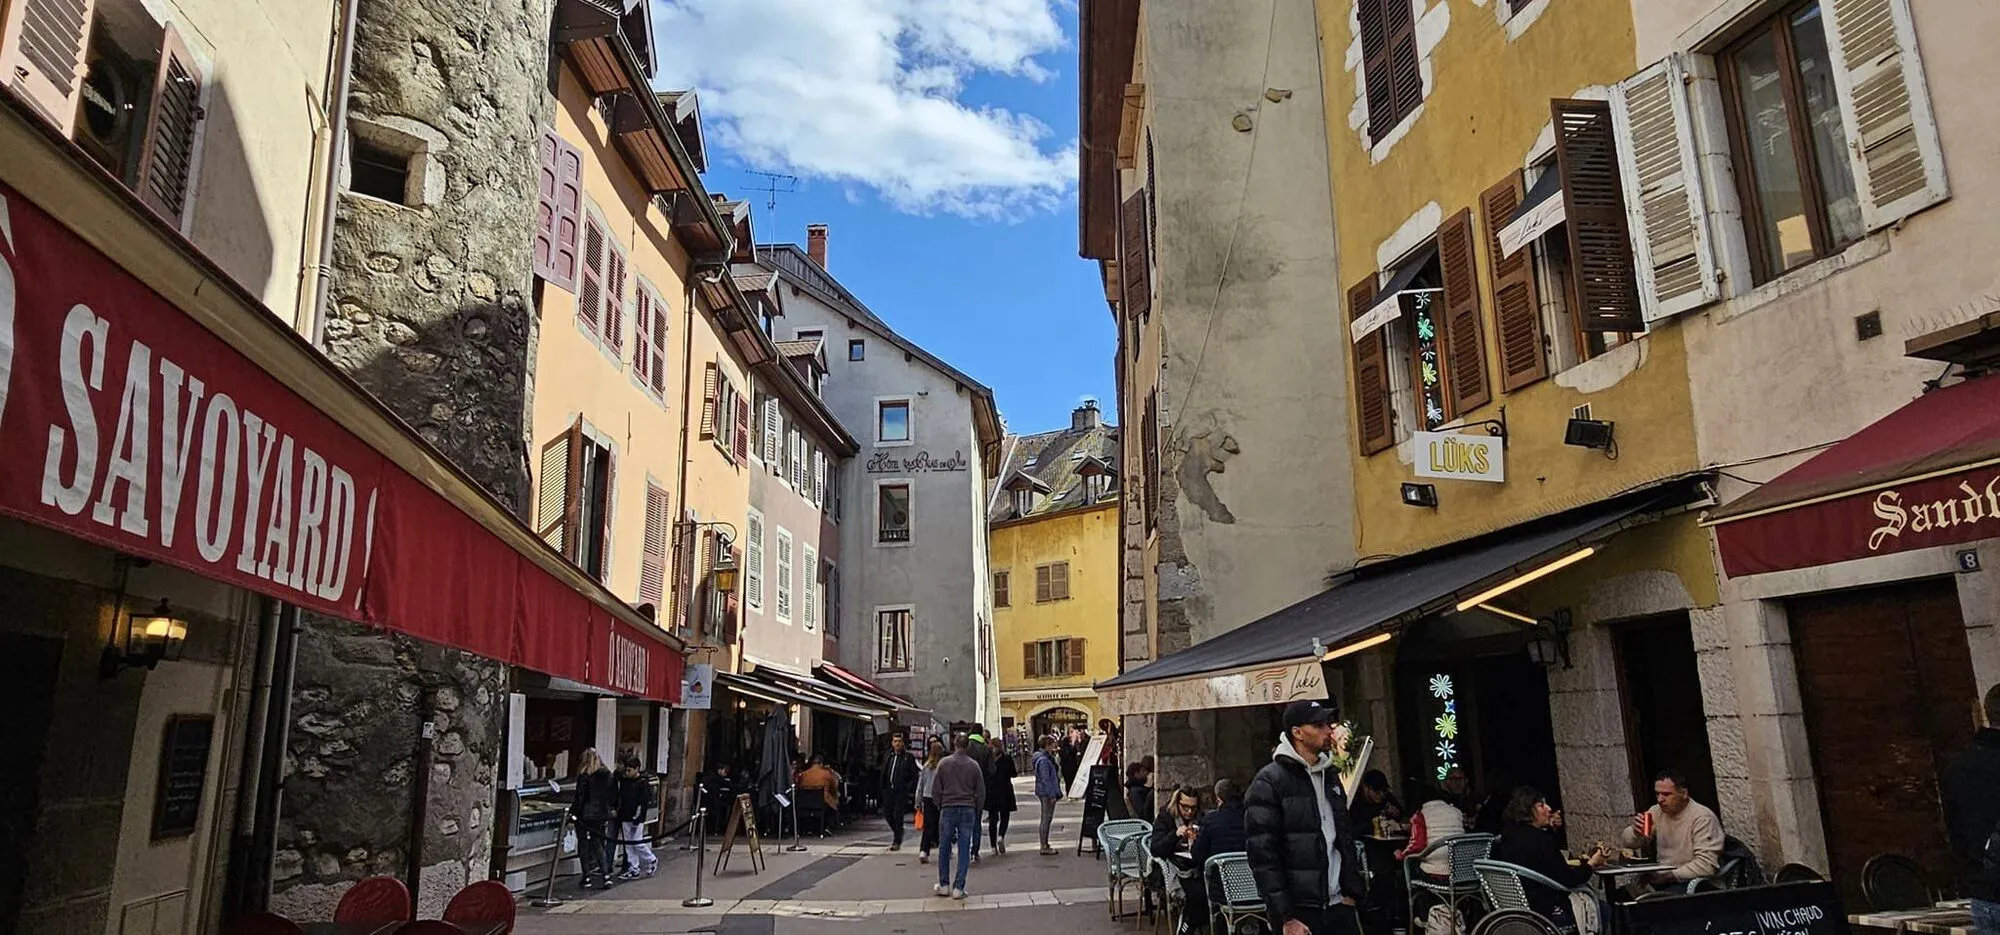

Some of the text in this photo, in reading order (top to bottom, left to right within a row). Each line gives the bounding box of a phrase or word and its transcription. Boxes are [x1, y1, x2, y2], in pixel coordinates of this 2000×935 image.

[41, 303, 356, 602] SAVOYARD
[354, 487, 378, 611] !
[1430, 437, 1489, 474] LÜKS
[1965, 553, 1976, 568] 8
[1760, 911, 1785, 929] VIN
[1783, 905, 1824, 925] CHAUD
